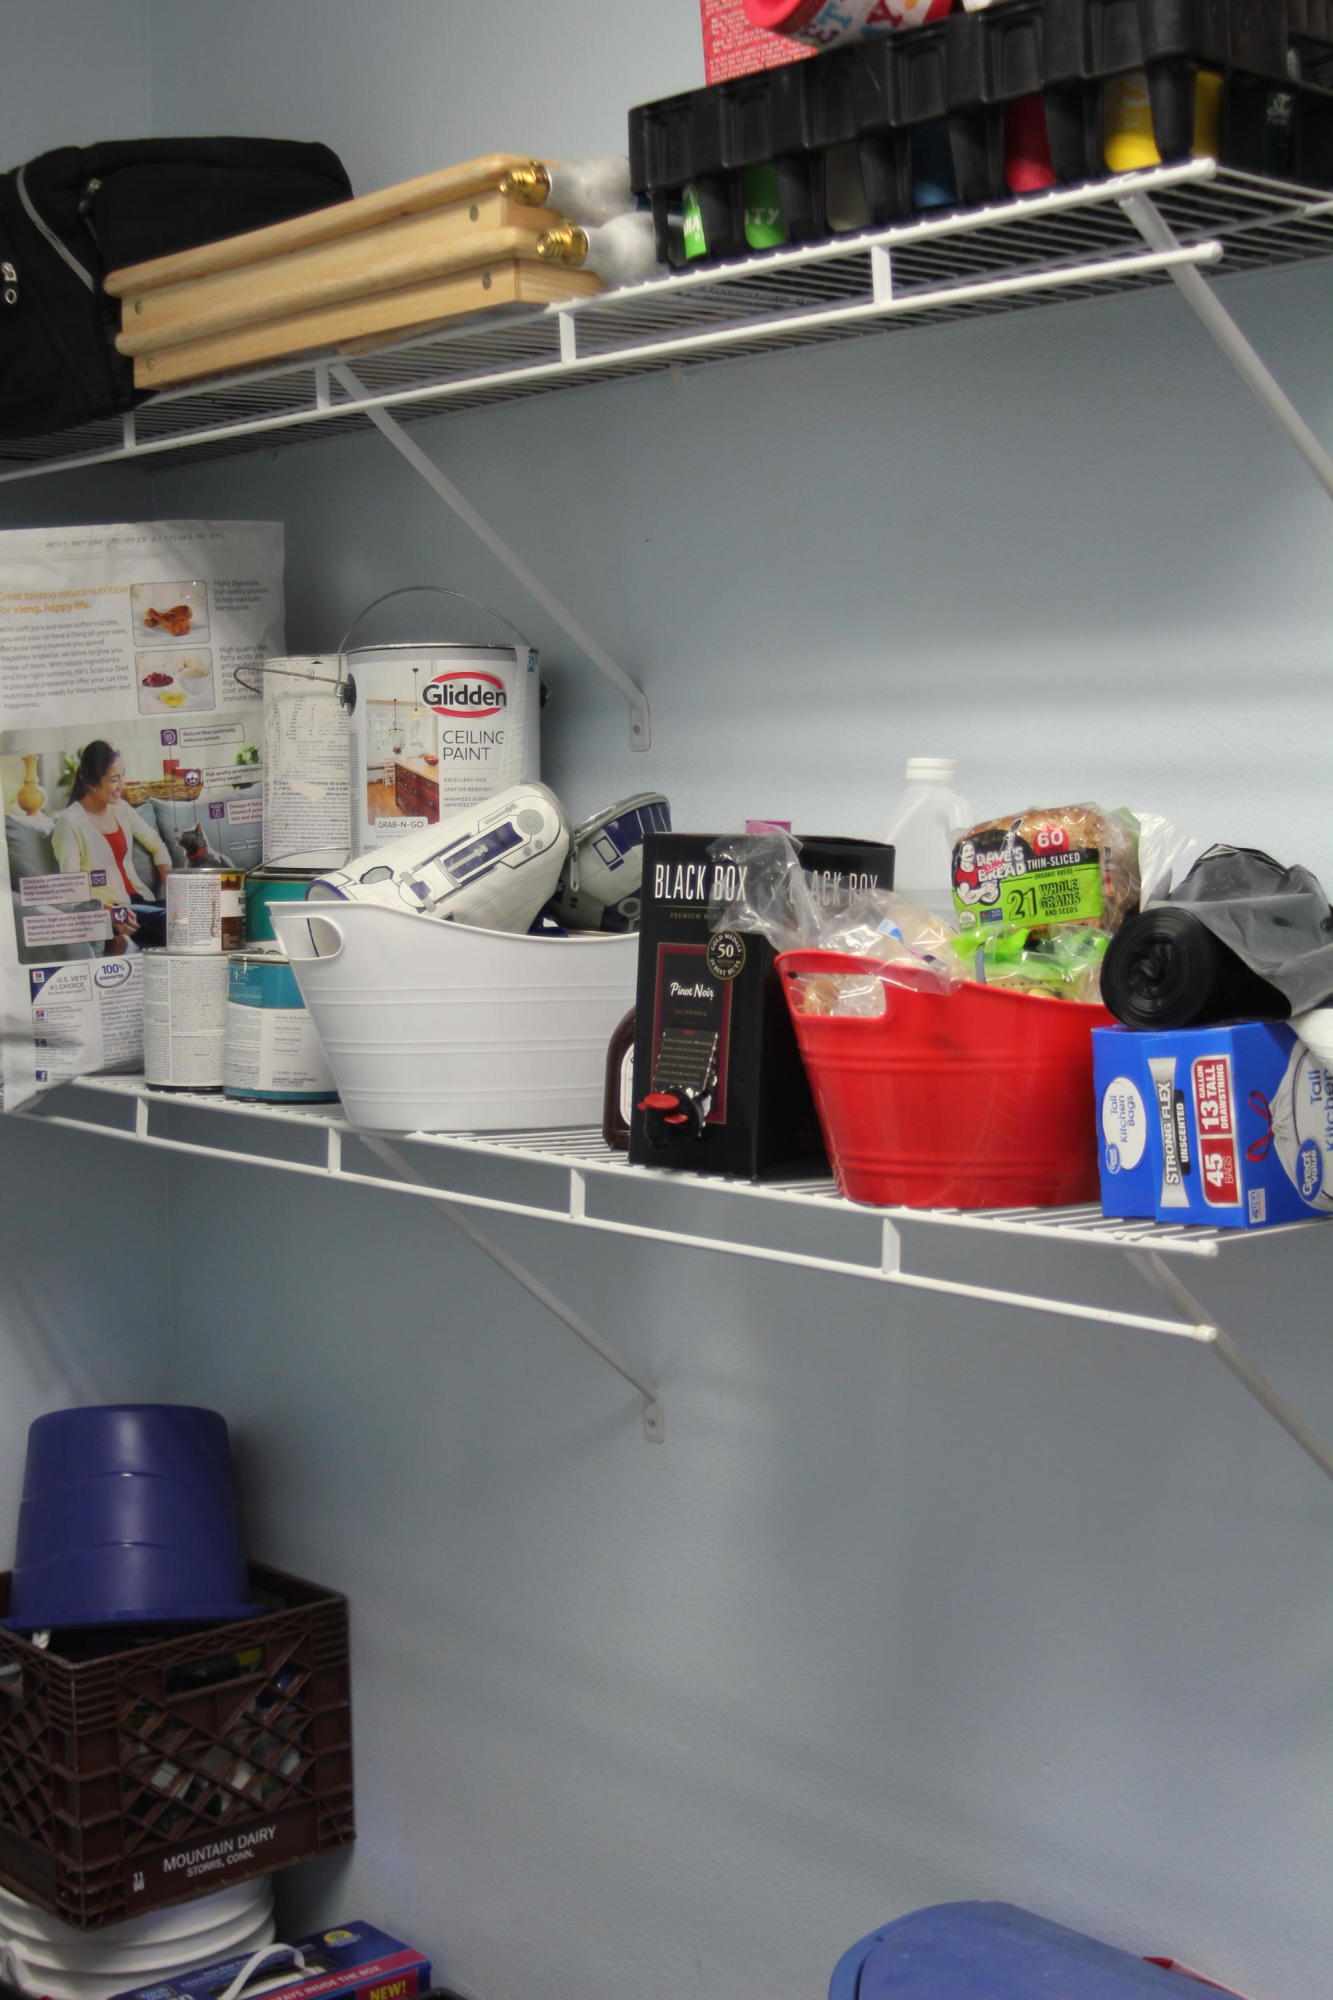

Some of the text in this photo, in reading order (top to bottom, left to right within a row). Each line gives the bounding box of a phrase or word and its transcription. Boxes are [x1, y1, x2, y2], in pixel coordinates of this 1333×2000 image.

[423, 684, 508, 706] Glidden
[442, 730, 505, 745] CEILING
[442, 747, 491, 761] PAINT
[377, 820, 424, 829] GRAB-N-GO
[1037, 829, 1064, 848] 60
[976, 846, 1024, 867] DAVE'S
[1027, 851, 1080, 870] THIN-SLICED
[655, 864, 748, 902] BLACK BOX
[977, 863, 1026, 882] BREAD
[1039, 878, 1079, 897] WHOLE
[1007, 887, 1038, 921] 21
[1039, 892, 1081, 910] GRAINS
[1045, 905, 1078, 917] AND SEEDS
[717, 943, 734, 959] 50
[59, 982, 85, 991] CHOICE
[670, 982, 715, 1001] Pinot Noir
[1194, 1065, 1205, 1098] GALLON
[1308, 1069, 1323, 1105] Tall
[1110, 1095, 1118, 1115] Tall
[1200, 1065, 1220, 1130] 13 TALL
[1216, 1064, 1229, 1129] DRAWSTRING
[1119, 1095, 1128, 1143] Kitchen
[1126, 1095, 1136, 1127] Bags
[1156, 1081, 1180, 1185] STRONG FLEX
[1175, 1102, 1190, 1163] UNSCENTED
[1205, 1153, 1224, 1187] 45
[1224, 1156, 1235, 1184] BAGS
[1302, 1151, 1313, 1196] Great
[163, 1825, 277, 1873] MOUNTAIN DAIRY
[186, 1849, 255, 1878] STORRS, CONN.
[304, 1979, 336, 1994] INSIDE
[337, 1971, 358, 1983] THE
[359, 1965, 382, 1977] BOX
[370, 1979, 408, 2000] NEW!
